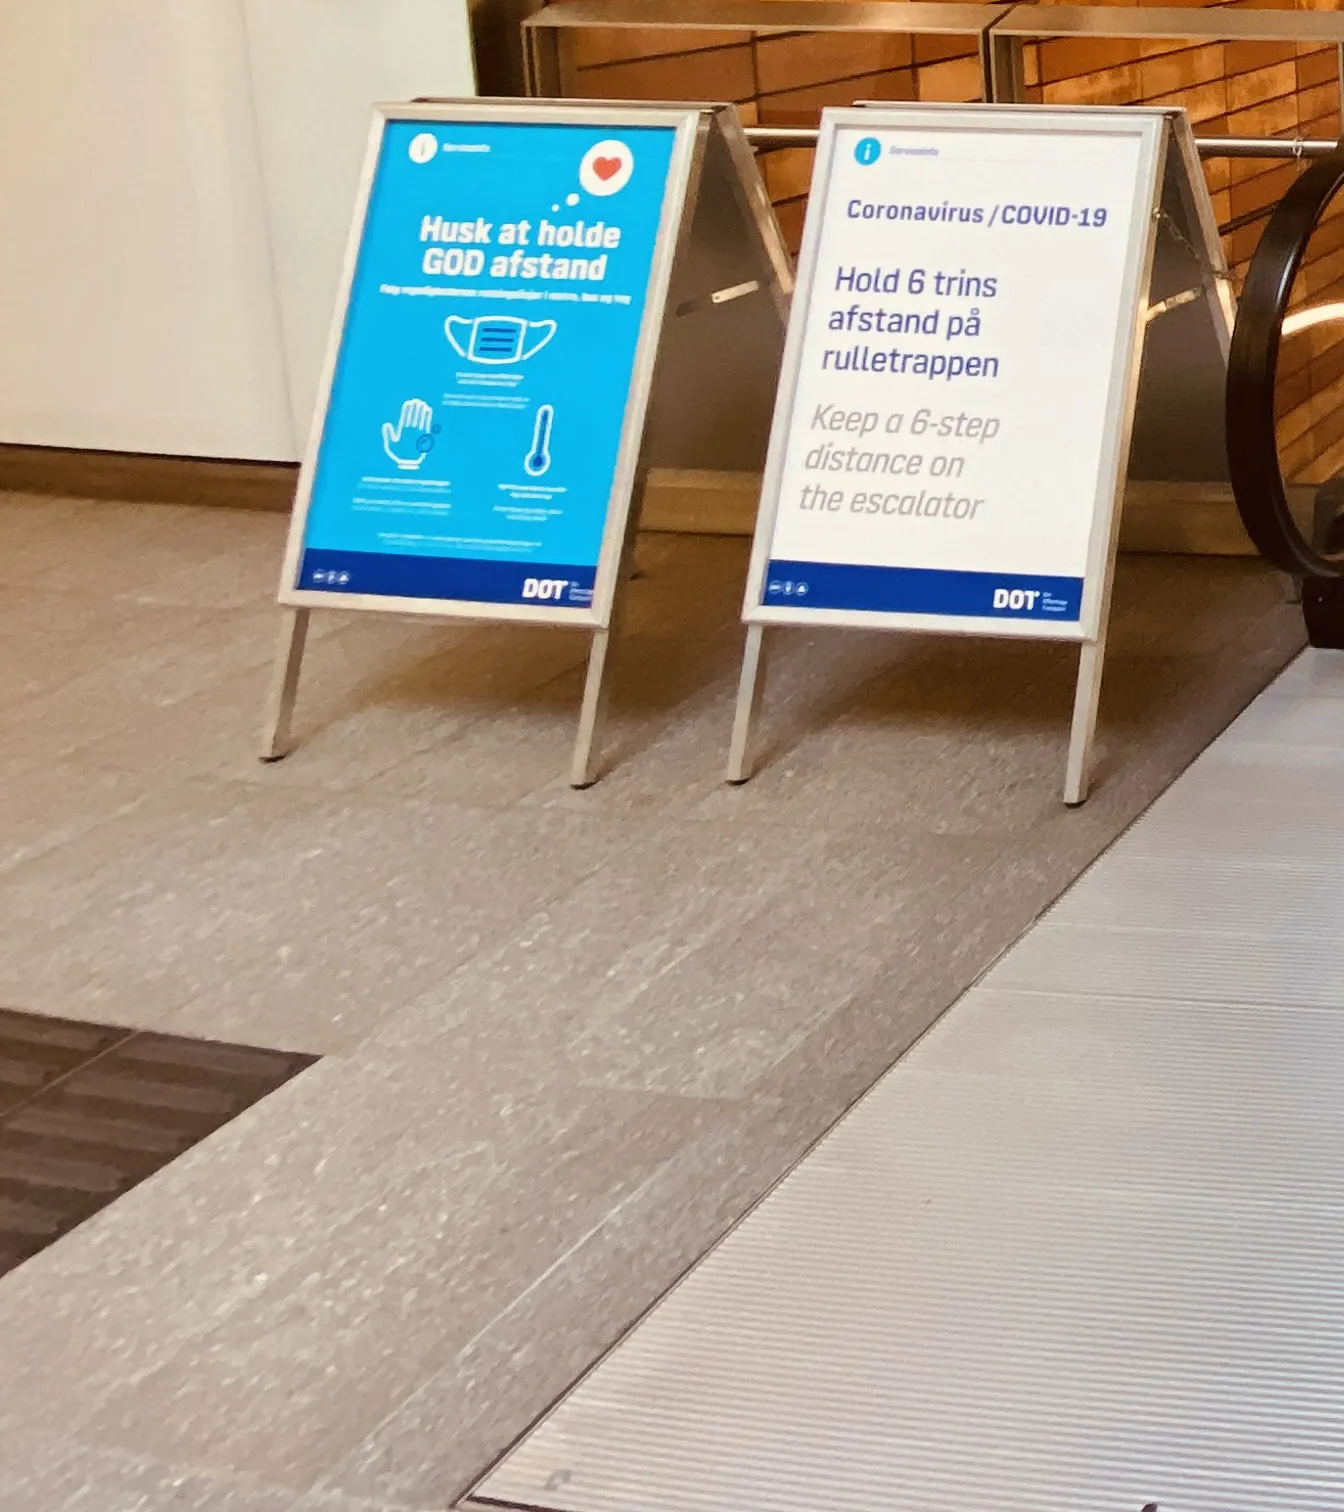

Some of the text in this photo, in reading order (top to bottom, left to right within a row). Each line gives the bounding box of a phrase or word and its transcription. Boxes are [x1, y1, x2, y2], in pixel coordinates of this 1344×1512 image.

[848, 200, 983, 223] Coronavirus
[420, 216, 621, 248] Husk at holde
[423, 248, 608, 280] GOD afstand
[836, 267, 997, 297] Hold 6 trins
[829, 305, 980, 340] afstand på
[823, 346, 998, 380] rulletrappen
[811, 404, 1000, 443] Keep a 6-step
[805, 442, 964, 477] distance on
[800, 484, 984, 519] the escalator
[522, 579, 568, 599] DOT
[993, 589, 1040, 610] DOT
